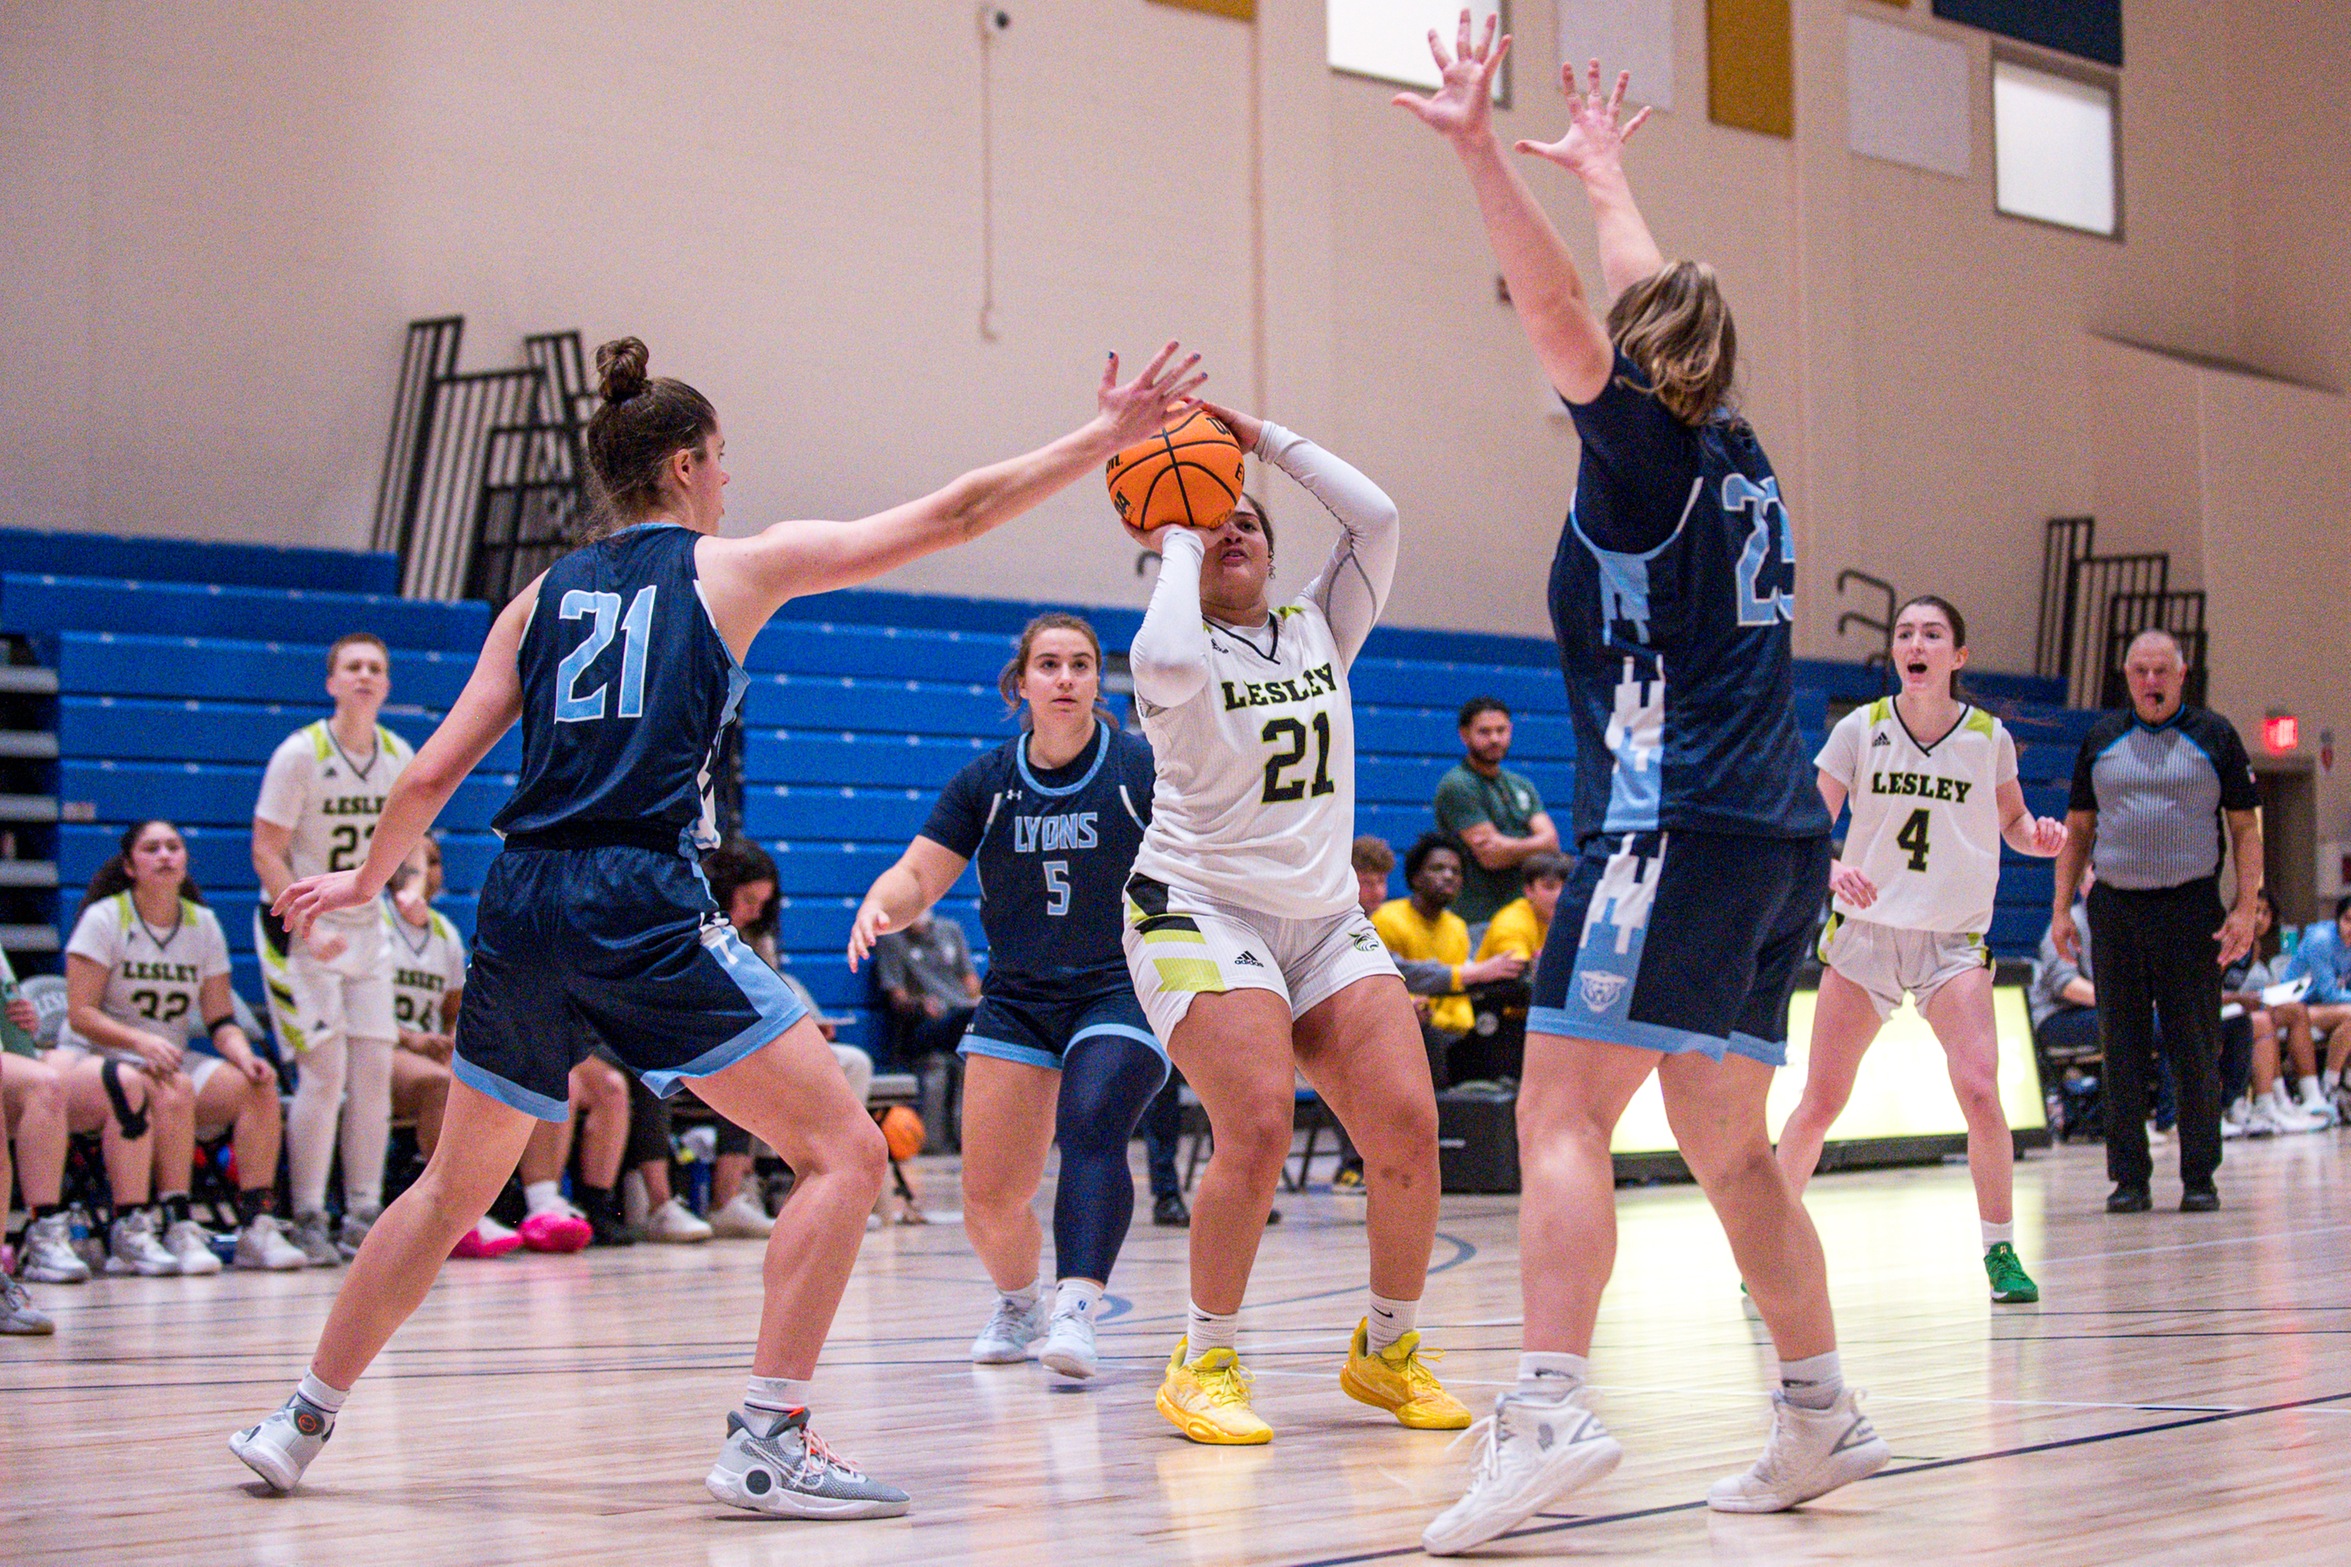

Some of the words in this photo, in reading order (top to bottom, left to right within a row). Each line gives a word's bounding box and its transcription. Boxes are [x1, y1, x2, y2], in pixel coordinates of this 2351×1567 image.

[554, 584, 658, 725] 21
[1221, 662, 1337, 711] LESLEY
[1260, 711, 1335, 806] 21
[1872, 771, 1973, 804] LESLEY
[328, 824, 377, 873] 2
[1014, 812, 1098, 853] LYONS
[1896, 808, 1931, 873] 4
[1042, 860, 1071, 916] 5
[123, 961, 198, 983] LESLEY
